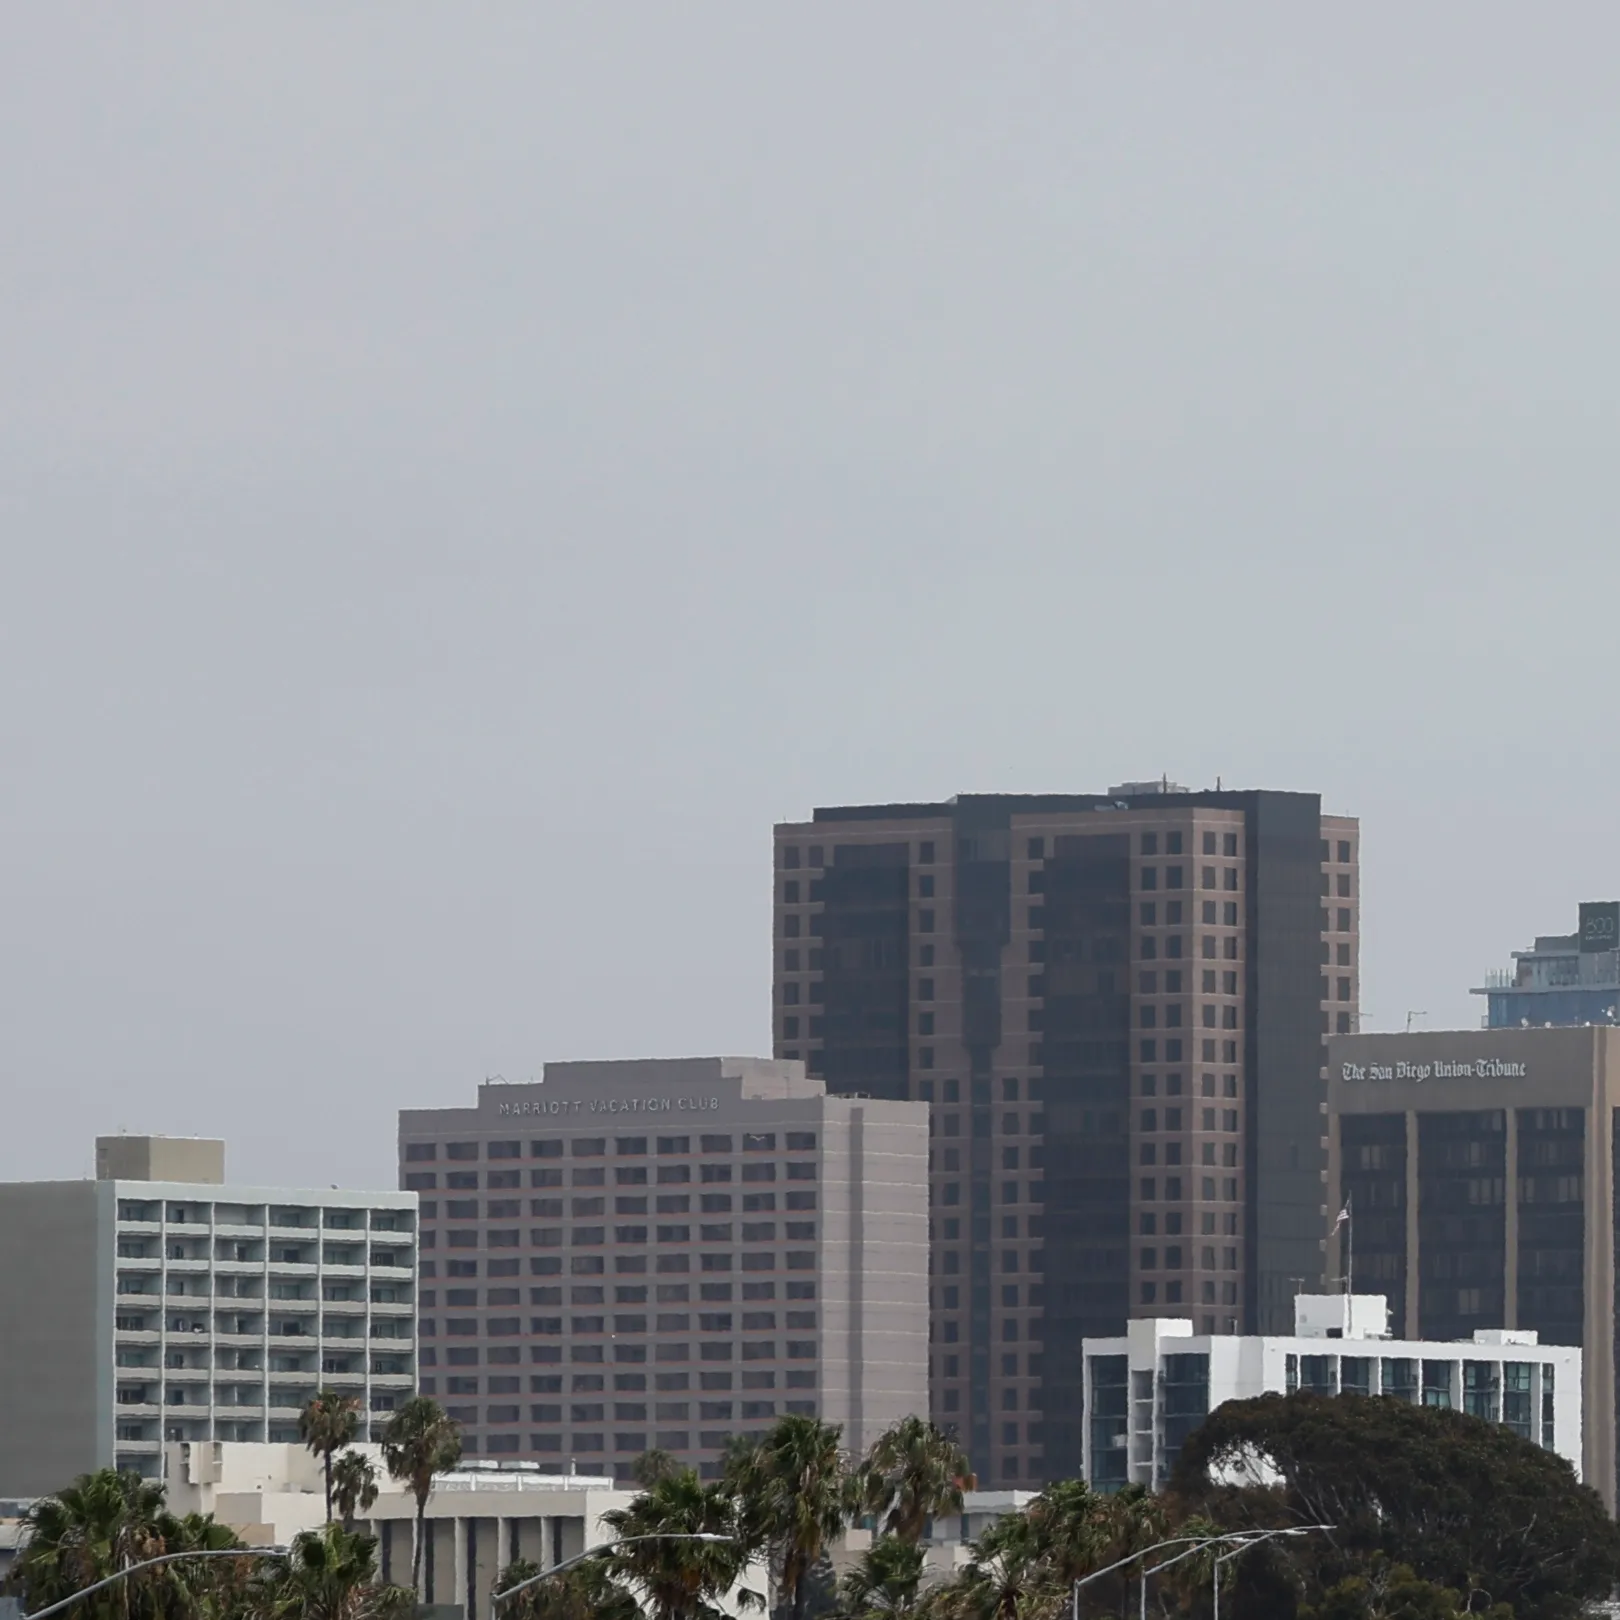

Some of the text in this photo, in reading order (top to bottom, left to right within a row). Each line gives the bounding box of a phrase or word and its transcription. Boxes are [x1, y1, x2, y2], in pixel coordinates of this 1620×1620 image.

[1342, 1058, 1527, 1082] The San Diego Union-Tribune
[499, 1097, 720, 1116] MARRIOTT VACATION CLUB
